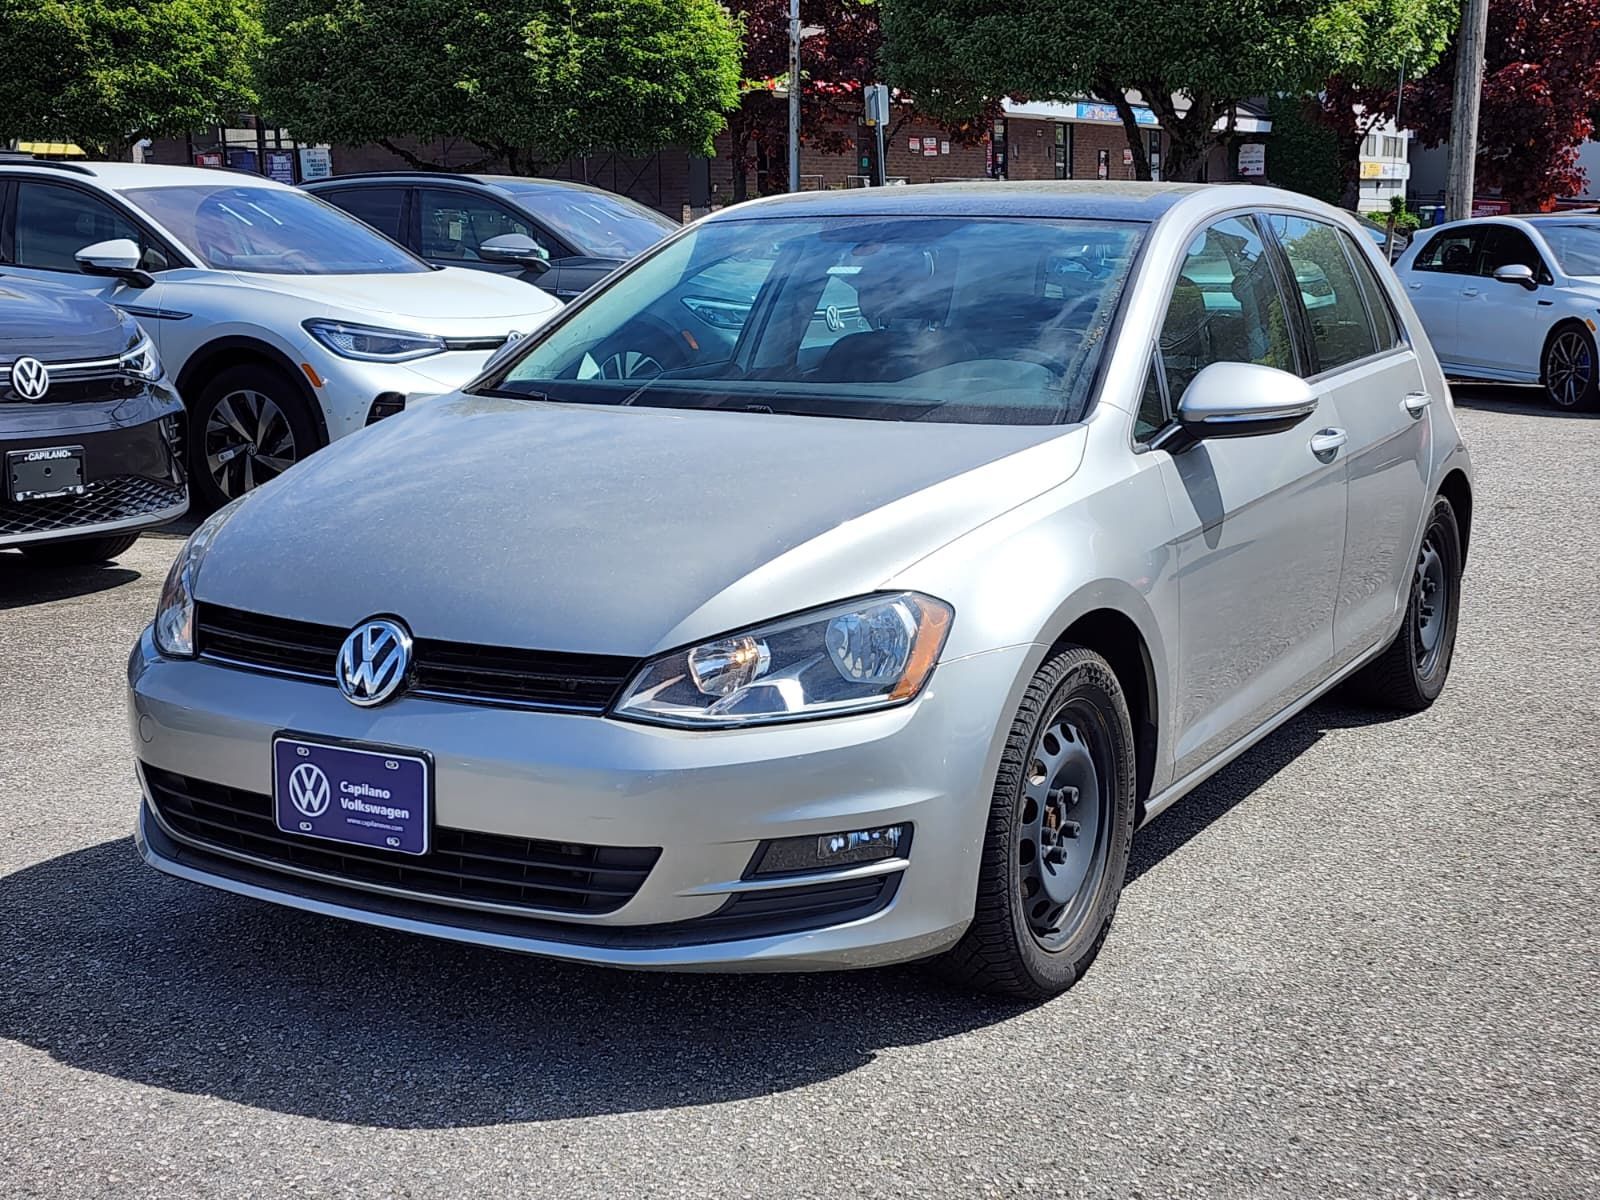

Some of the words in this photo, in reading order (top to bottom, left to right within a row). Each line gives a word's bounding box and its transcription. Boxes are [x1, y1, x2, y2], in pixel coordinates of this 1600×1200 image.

[28, 449, 68, 461] CAPILANO
[340, 780, 391, 800] Capilano
[340, 796, 410, 820] Volkswagen
